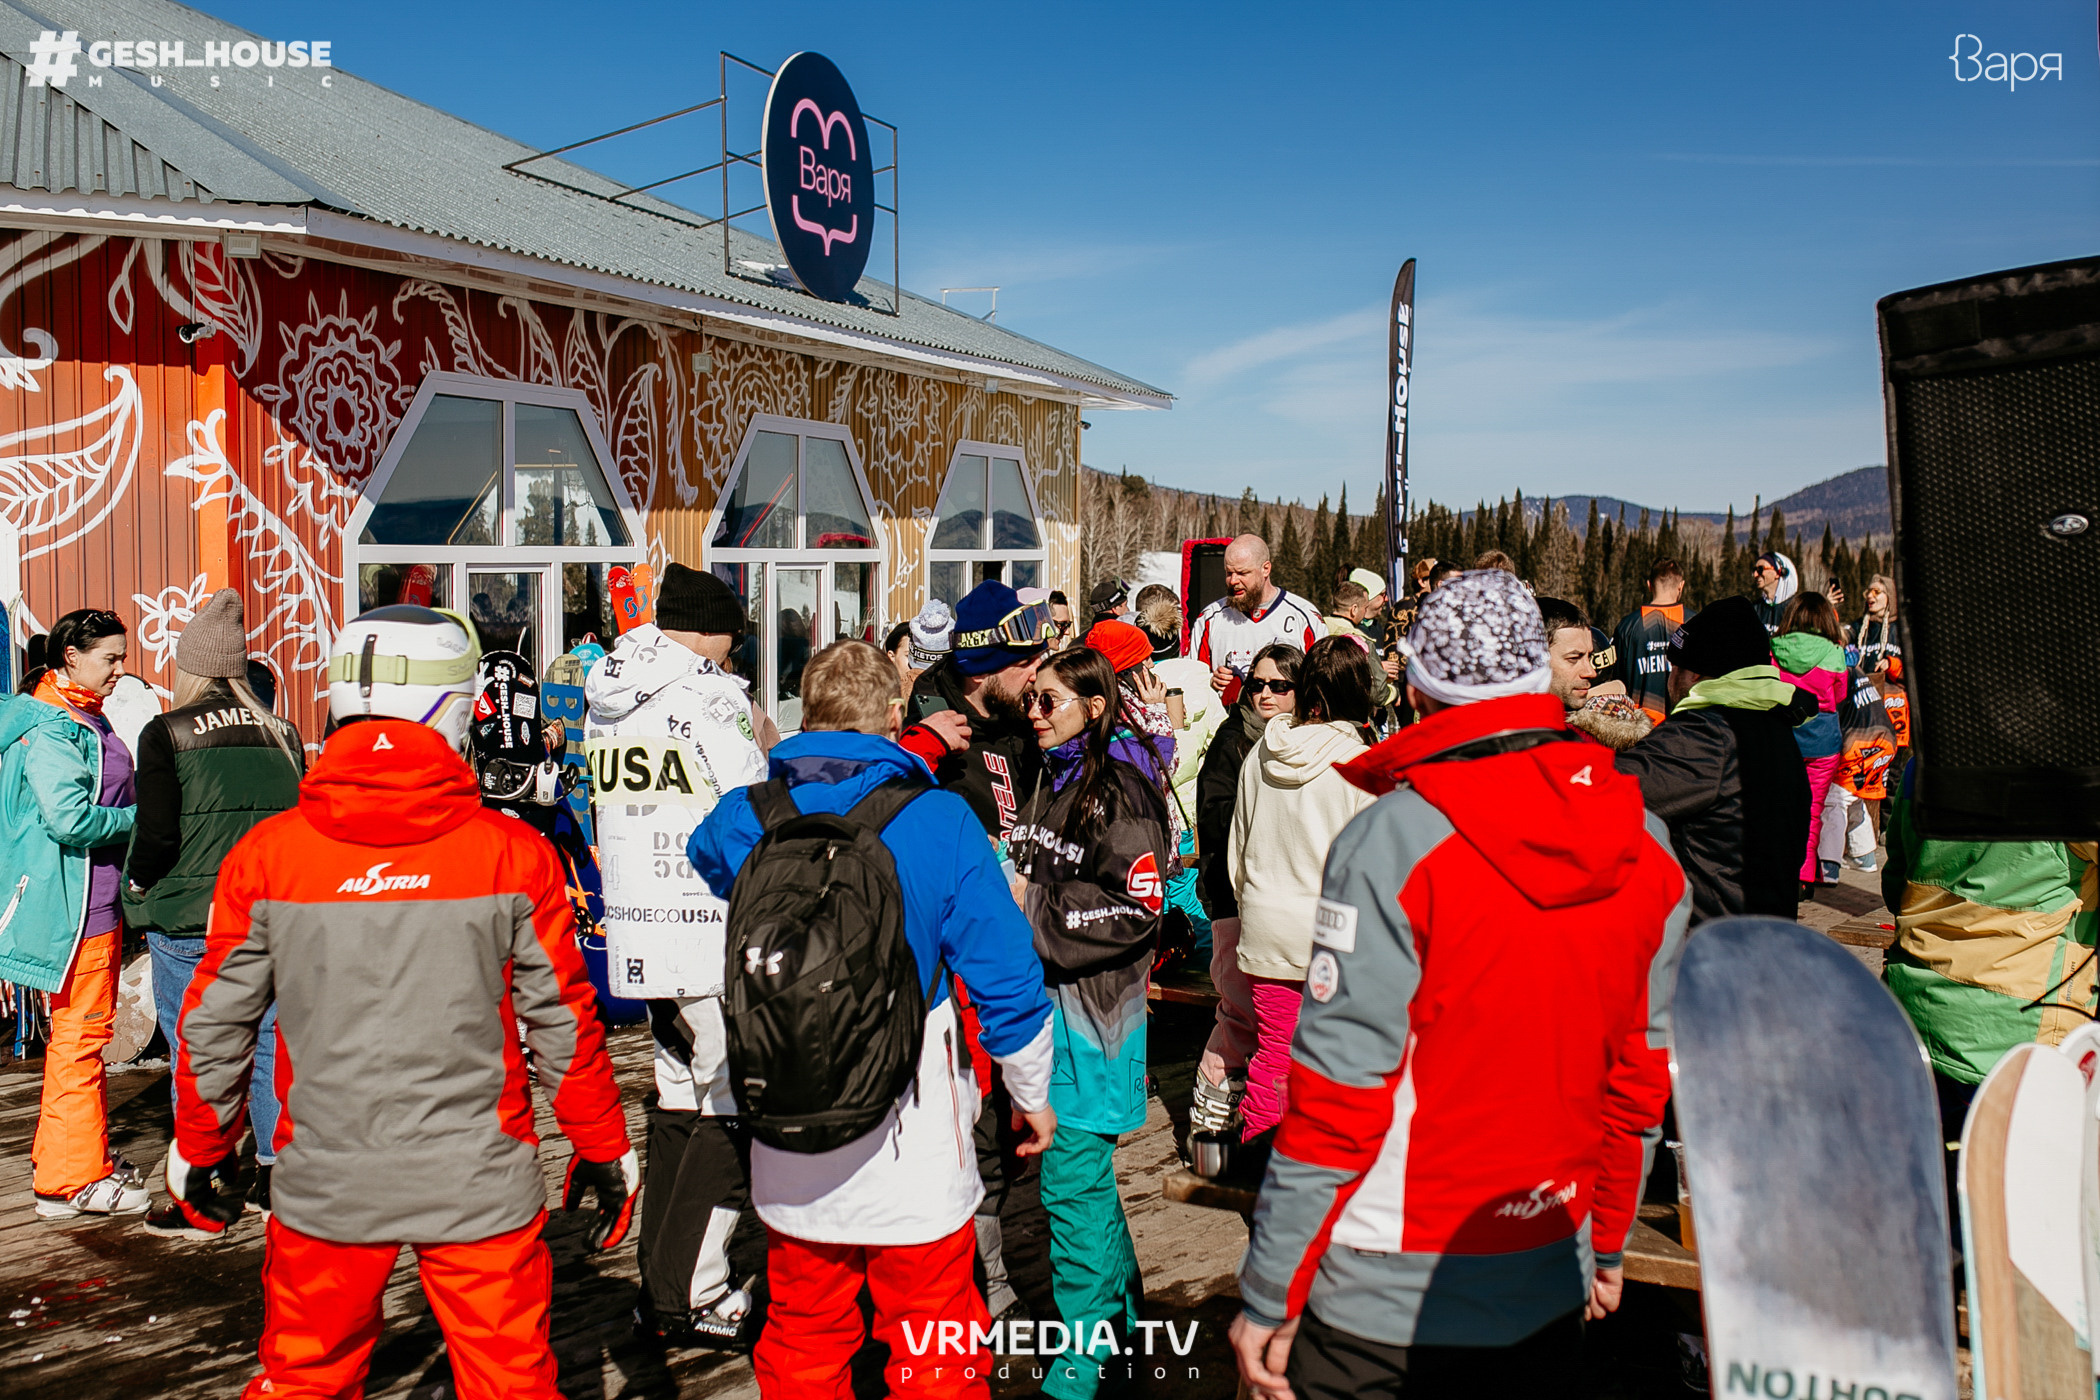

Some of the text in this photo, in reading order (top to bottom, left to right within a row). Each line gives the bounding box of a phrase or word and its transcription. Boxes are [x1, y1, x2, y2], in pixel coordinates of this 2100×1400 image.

[799, 145, 852, 207] Варя
[1283, 615, 1295, 633] C
[590, 746, 694, 794] USA
[336, 862, 430, 895] AUSTRIA
[694, 1321, 738, 1337] ATOMIC
[1727, 1361, 1922, 1400] RTON
